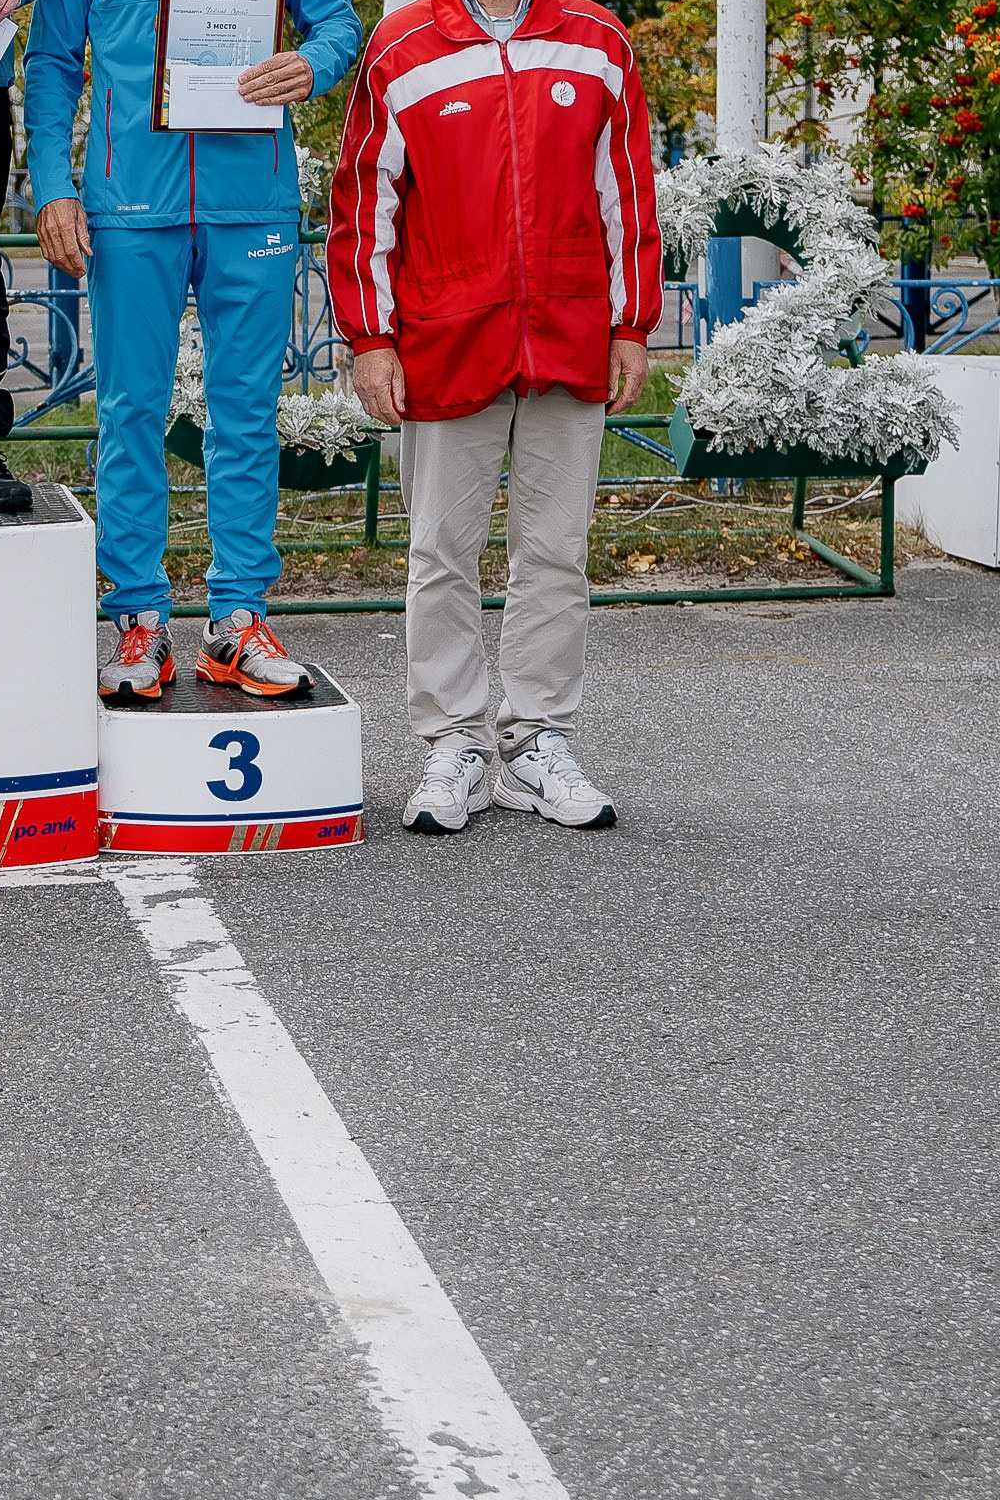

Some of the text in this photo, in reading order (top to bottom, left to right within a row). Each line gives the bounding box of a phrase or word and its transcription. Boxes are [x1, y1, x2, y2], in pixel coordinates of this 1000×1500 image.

[206, 21, 212, 30] 3
[247, 243, 294, 259] NORDSKI
[206, 729, 263, 802] 3
